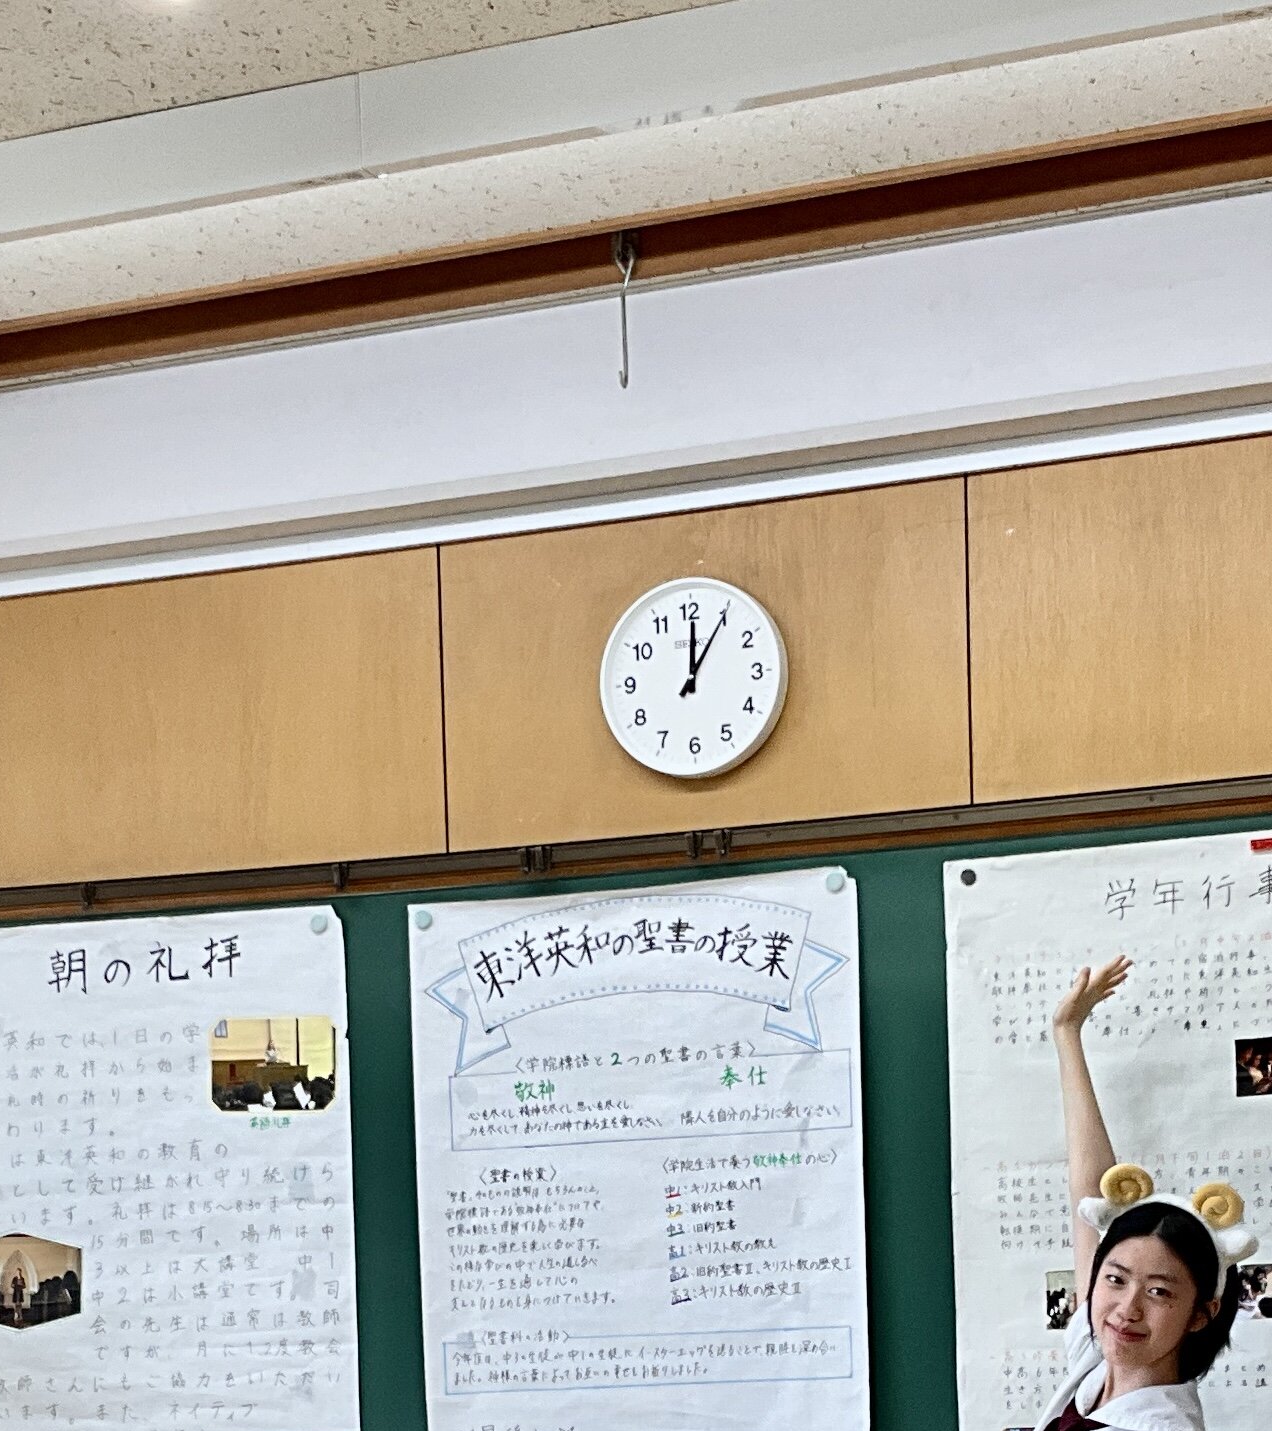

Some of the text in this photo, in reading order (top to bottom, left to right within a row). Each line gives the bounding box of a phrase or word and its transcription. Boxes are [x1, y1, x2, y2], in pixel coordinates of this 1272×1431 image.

[679, 602, 700, 621] 12
[719, 609, 727, 627] 1
[653, 615, 669, 634] 11
[674, 637, 709, 650] SEKO
[742, 631, 754, 649] 2
[632, 642, 653, 661] 10
[751, 662, 764, 680] 3
[624, 676, 636, 694] 9
[742, 696, 755, 714] 4
[634, 708, 647, 726] 8
[657, 730, 669, 749] 7
[720, 724, 733, 742] 5
[689, 736, 701, 754] 6
[47, 935, 241, 996] 朝の礼拝
[473, 917, 795, 1003] 東洋英和の聖書の授業
[719, 1064, 768, 1090] 奉仕
